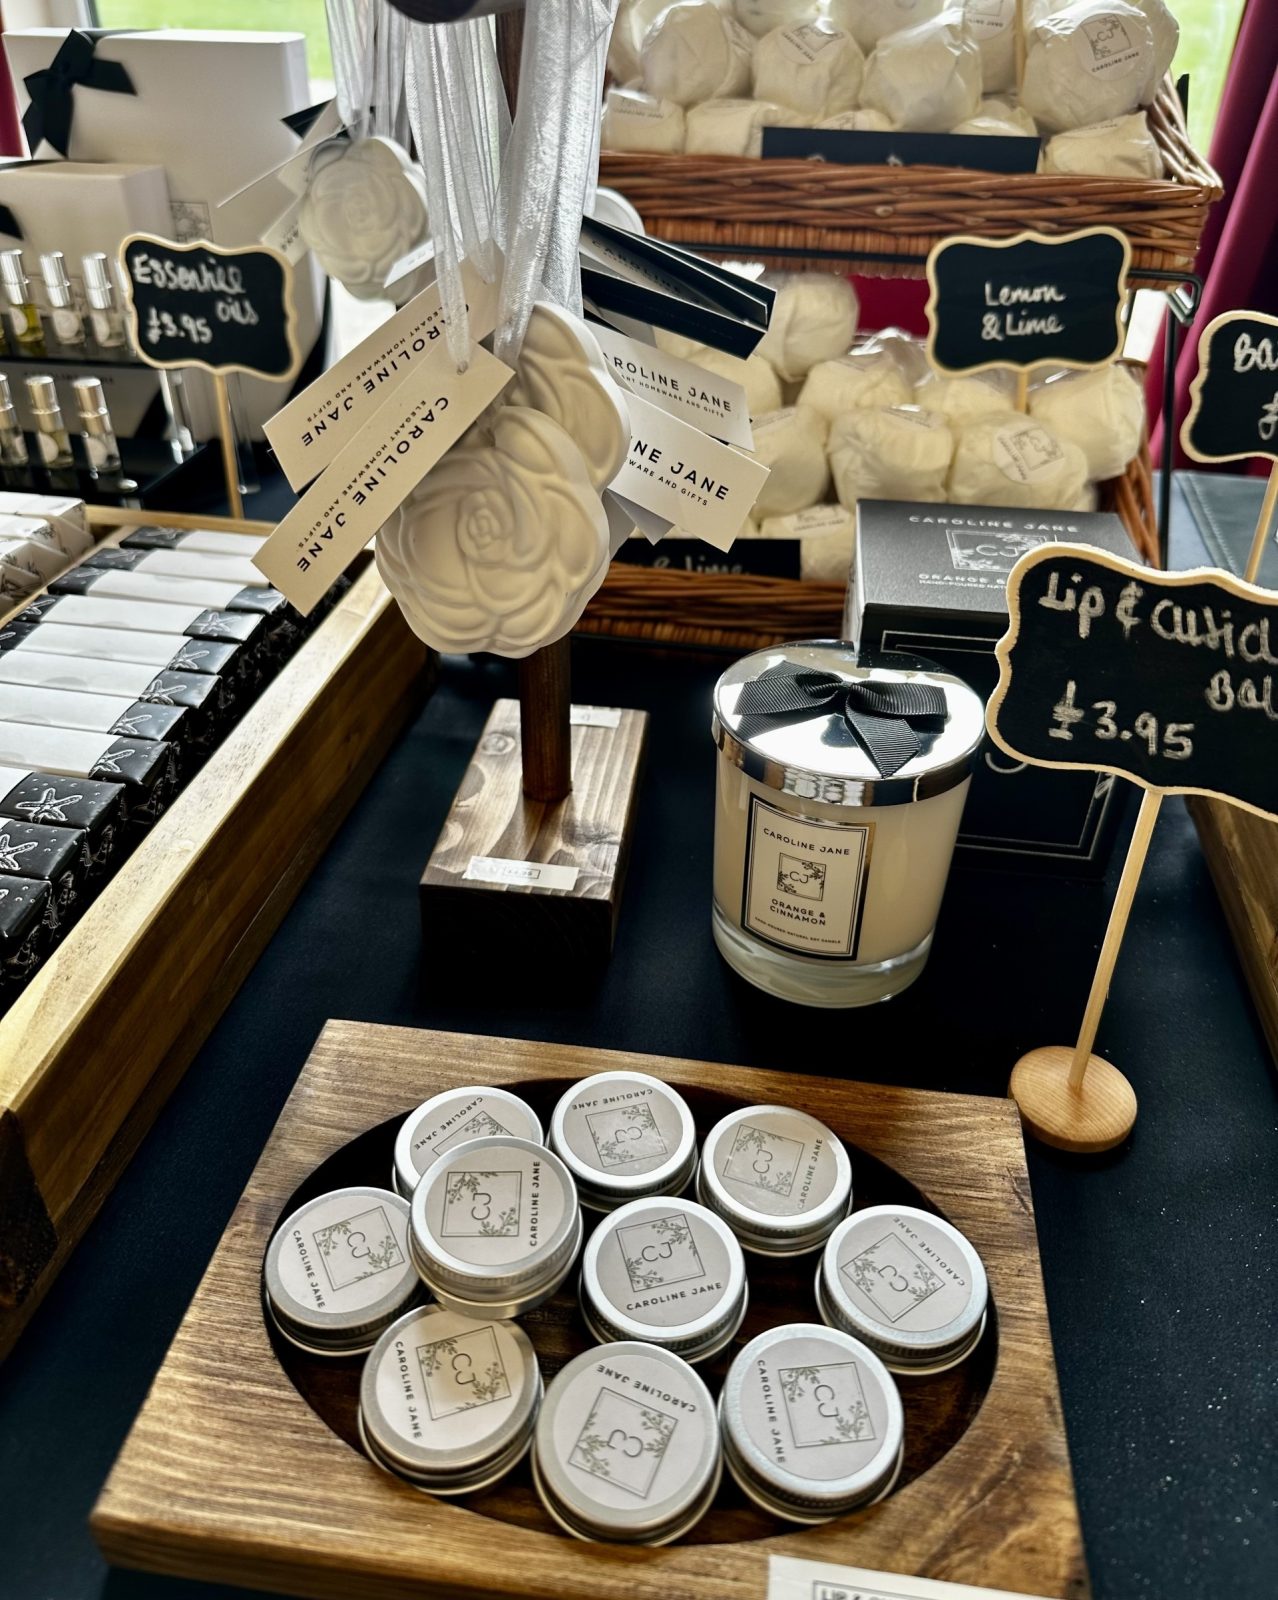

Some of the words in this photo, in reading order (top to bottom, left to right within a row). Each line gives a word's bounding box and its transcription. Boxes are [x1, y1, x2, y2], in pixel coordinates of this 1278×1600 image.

[985, 281, 1067, 306] Lemon
[981, 313, 1004, 341] &
[1006, 309, 1065, 336] Lime
[363, 304, 469, 394] ROLINE
[335, 383, 352, 399] AND
[639, 381, 683, 401] HOMEWARE
[686, 400, 701, 409] AND
[704, 406, 725, 418] GIFTS
[688, 387, 732, 412] JANE
[301, 396, 353, 446] JANE
[307, 399, 332, 423] GIFTS
[390, 401, 427, 441] ELEGANT
[353, 397, 449, 505] CAROLINE
[342, 444, 388, 496] HOMEWARE
[629, 459, 655, 477] WARE
[659, 476, 678, 489] AND
[680, 488, 708, 506] GIFTS
[671, 462, 729, 500] JANE
[324, 500, 340, 518] AND
[299, 521, 322, 548] GIFTS
[908, 515, 1014, 529] CAROLINE
[1023, 523, 1080, 533] JANE
[297, 513, 346, 572] JANE
[918, 573, 988, 584] ORANGE
[1038, 571, 1106, 639] Lip
[1116, 581, 1144, 639] &
[1204, 669, 1278, 721] Bal
[1048, 679, 1196, 760] £3.95
[763, 827, 815, 851] CAROLINE
[820, 846, 850, 856] JANE
[789, 871, 809, 884] CJ
[769, 905, 827, 926] CINNAMON
[772, 898, 815, 917] ORANGE
[572, 1100, 599, 1110] JANE
[603, 1088, 653, 1105] CAROLINE
[440, 1097, 483, 1132] CAROLINE
[414, 1131, 438, 1150] JANE
[810, 1138, 823, 1163] JANE
[532, 1161, 541, 1188] JANE
[752, 1149, 774, 1174] CJ
[471, 1192, 492, 1221] CJ
[529, 1192, 541, 1247] CAROLINE
[893, 1216, 918, 1239] JANE
[347, 1231, 371, 1259] CJ
[641, 1241, 673, 1262] CJ
[293, 1230, 315, 1279] CAROLINE
[310, 1281, 326, 1308] JANE
[918, 1241, 965, 1286] CAROLINE
[878, 1265, 909, 1292] CJ
[626, 1290, 687, 1311] CAROLINE
[691, 1282, 722, 1296] JANE
[451, 1353, 477, 1385] CJ
[596, 1364, 630, 1384] JANE
[395, 1341, 415, 1401] CAROLINE
[408, 1406, 422, 1439] JANE
[633, 1380, 697, 1412] CAROLINE
[814, 1384, 840, 1418] CJ
[757, 1359, 777, 1423] CAROLINE
[771, 1428, 786, 1463] JANE
[607, 1429, 643, 1457] CJ
